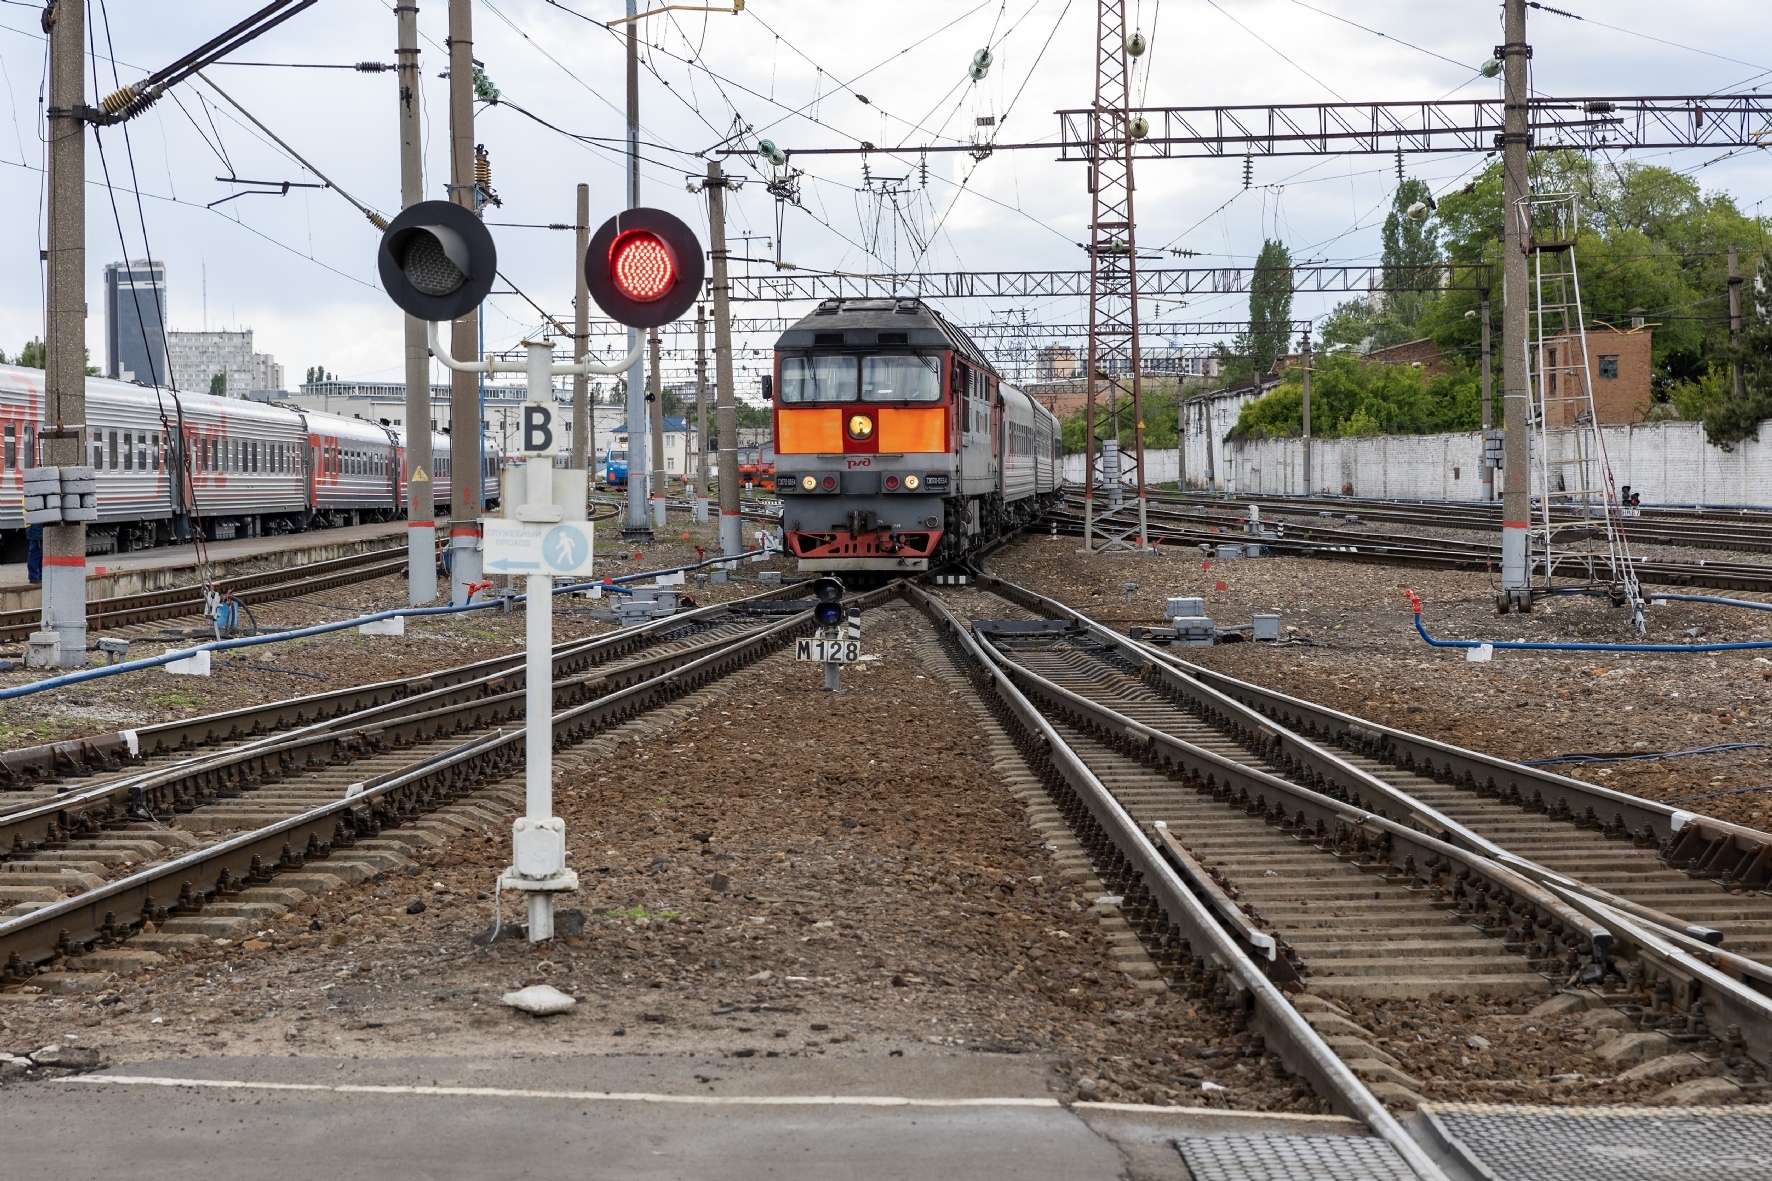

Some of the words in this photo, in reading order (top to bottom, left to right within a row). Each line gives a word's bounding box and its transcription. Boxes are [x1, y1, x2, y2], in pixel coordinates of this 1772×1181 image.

[981, 117, 992, 126] 10
[524, 406, 553, 451] В
[486, 528, 542, 538] СЛУЖЕБНЫЙ
[495, 538, 531, 548] ПРОХОД
[797, 640, 858, 662] М128
